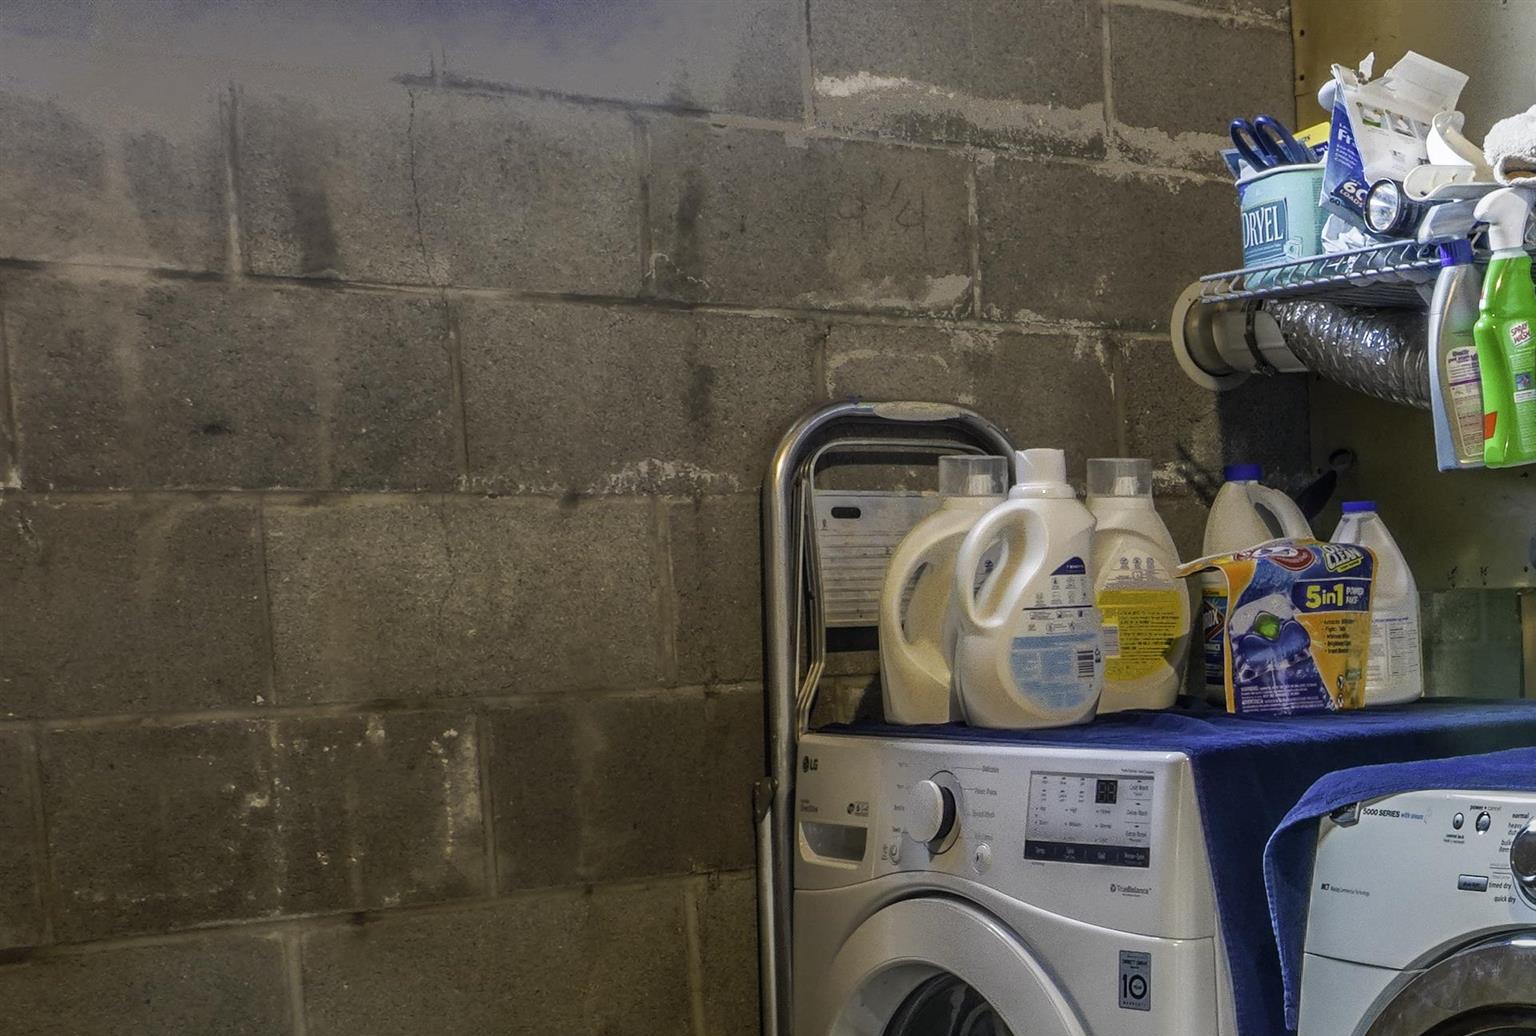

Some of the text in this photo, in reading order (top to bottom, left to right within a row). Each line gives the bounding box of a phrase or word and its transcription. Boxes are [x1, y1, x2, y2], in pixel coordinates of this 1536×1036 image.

[1241, 205, 1284, 249] DRYEL
[809, 758, 818, 771] LG
[1363, 808, 1378, 816] 5000
[1379, 809, 1400, 818] SERIES
[1503, 881, 1512, 890] dry
[1507, 896, 1517, 904] dry
[1122, 973, 1148, 1000] 10
